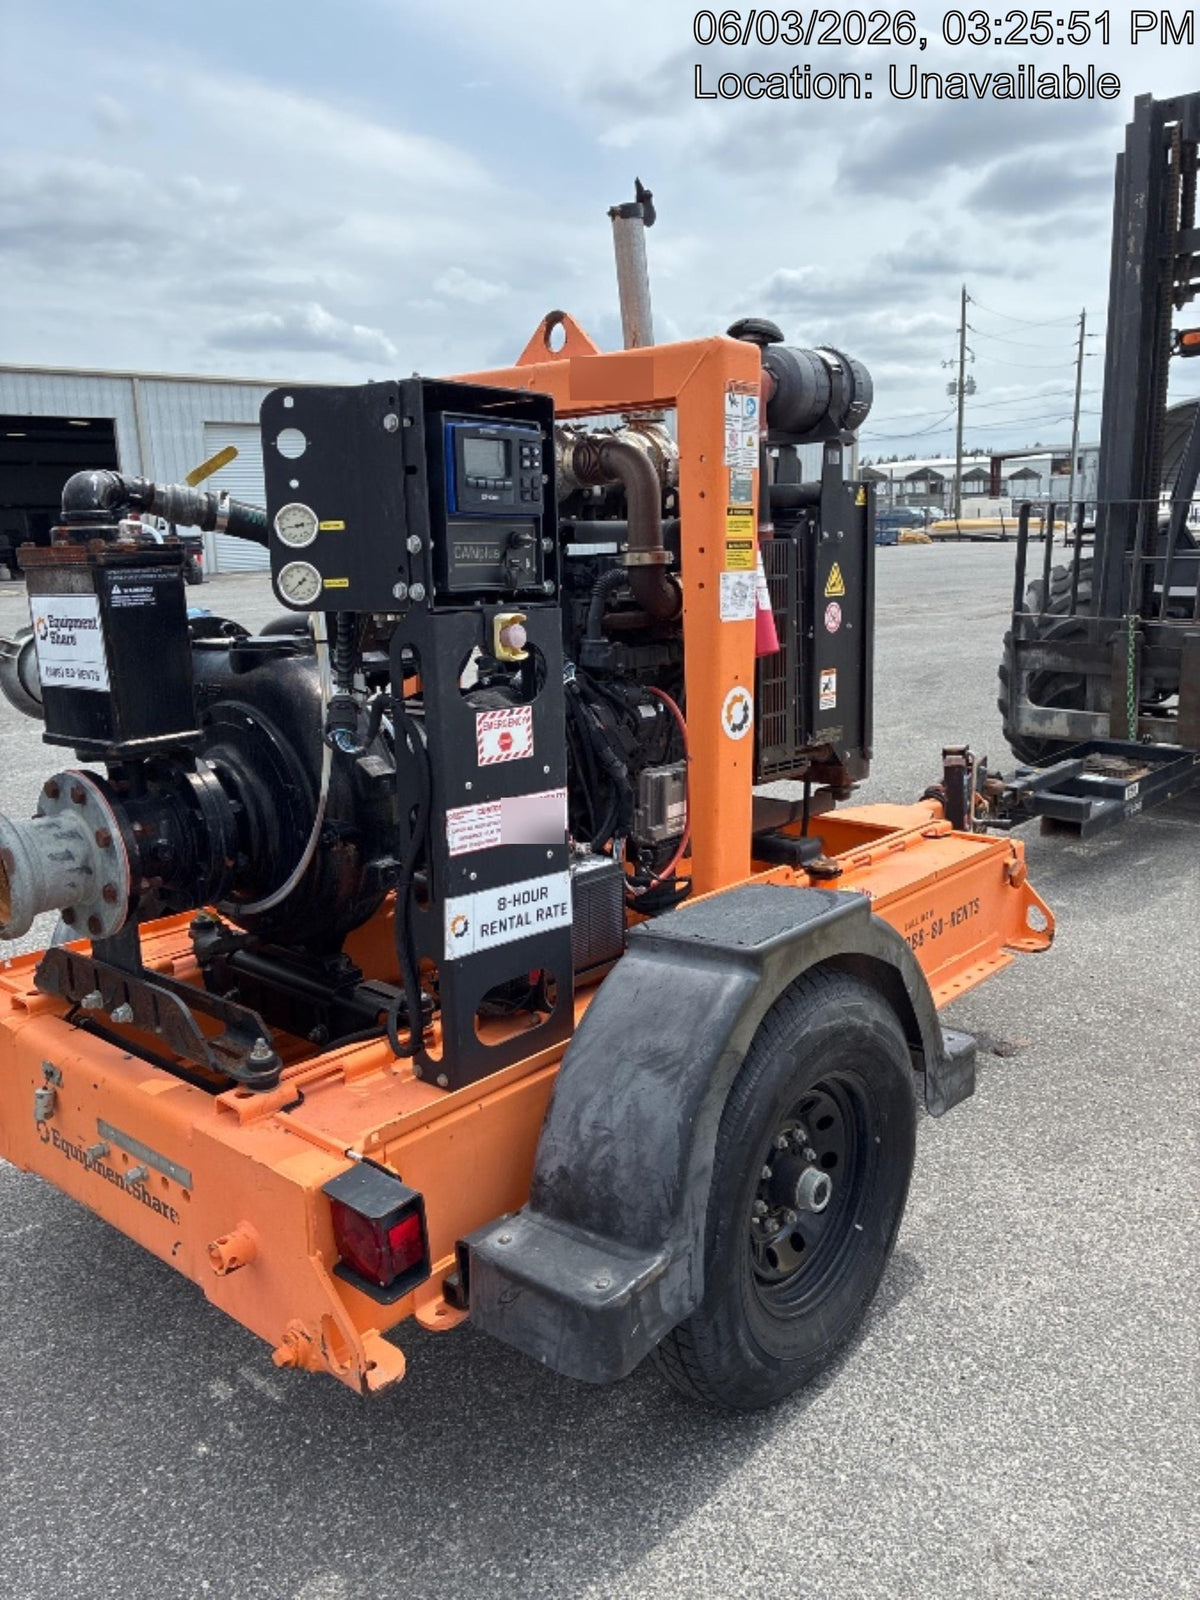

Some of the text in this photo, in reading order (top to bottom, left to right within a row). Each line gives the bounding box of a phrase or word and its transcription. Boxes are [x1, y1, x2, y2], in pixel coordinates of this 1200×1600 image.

[47, 615, 98, 633] Equipment
[483, 716, 527, 731] EMERGENCY
[497, 886, 549, 911] 8-HOUR
[480, 902, 568, 937] RENTAL RATE
